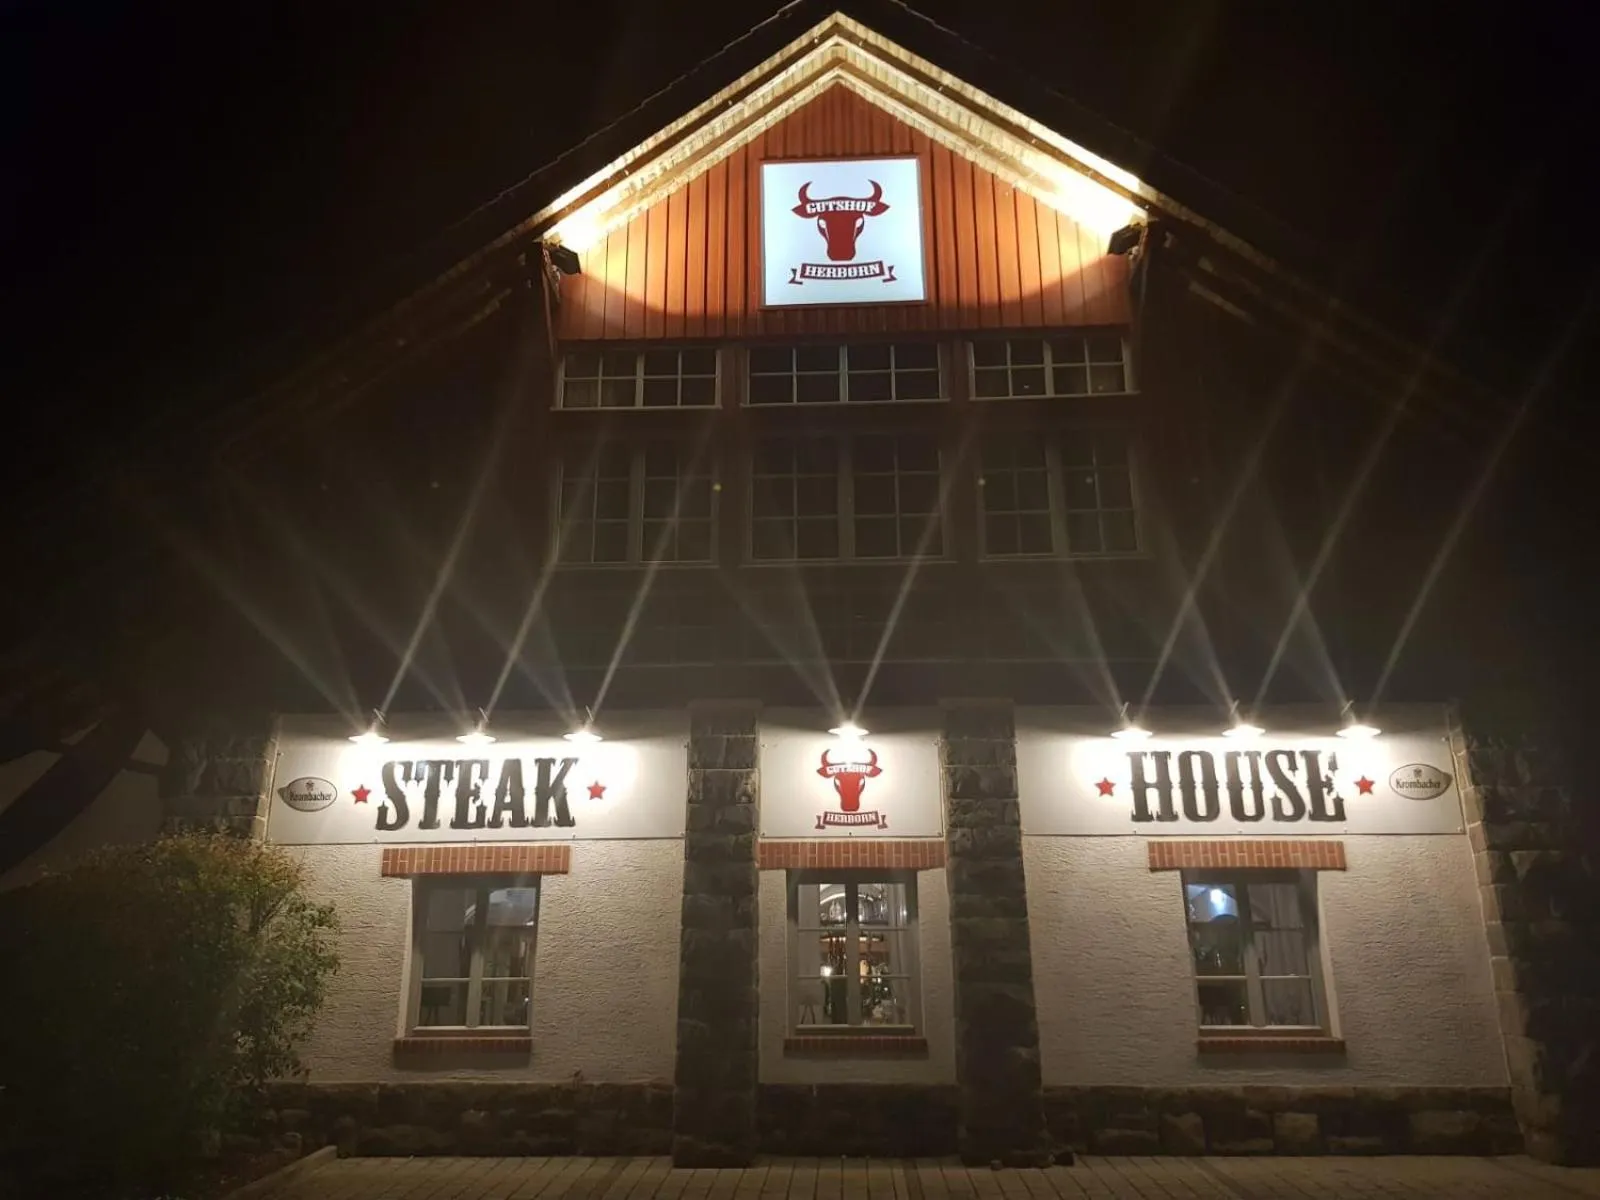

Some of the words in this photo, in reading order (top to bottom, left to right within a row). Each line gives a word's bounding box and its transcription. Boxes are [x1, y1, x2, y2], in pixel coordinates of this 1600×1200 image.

[806, 200, 876, 214] GUTSHOF
[805, 264, 881, 278] HERBORN
[1126, 750, 1347, 823] HOUSE
[1395, 778, 1441, 789] Krombacher
[375, 757, 579, 831] STEAK
